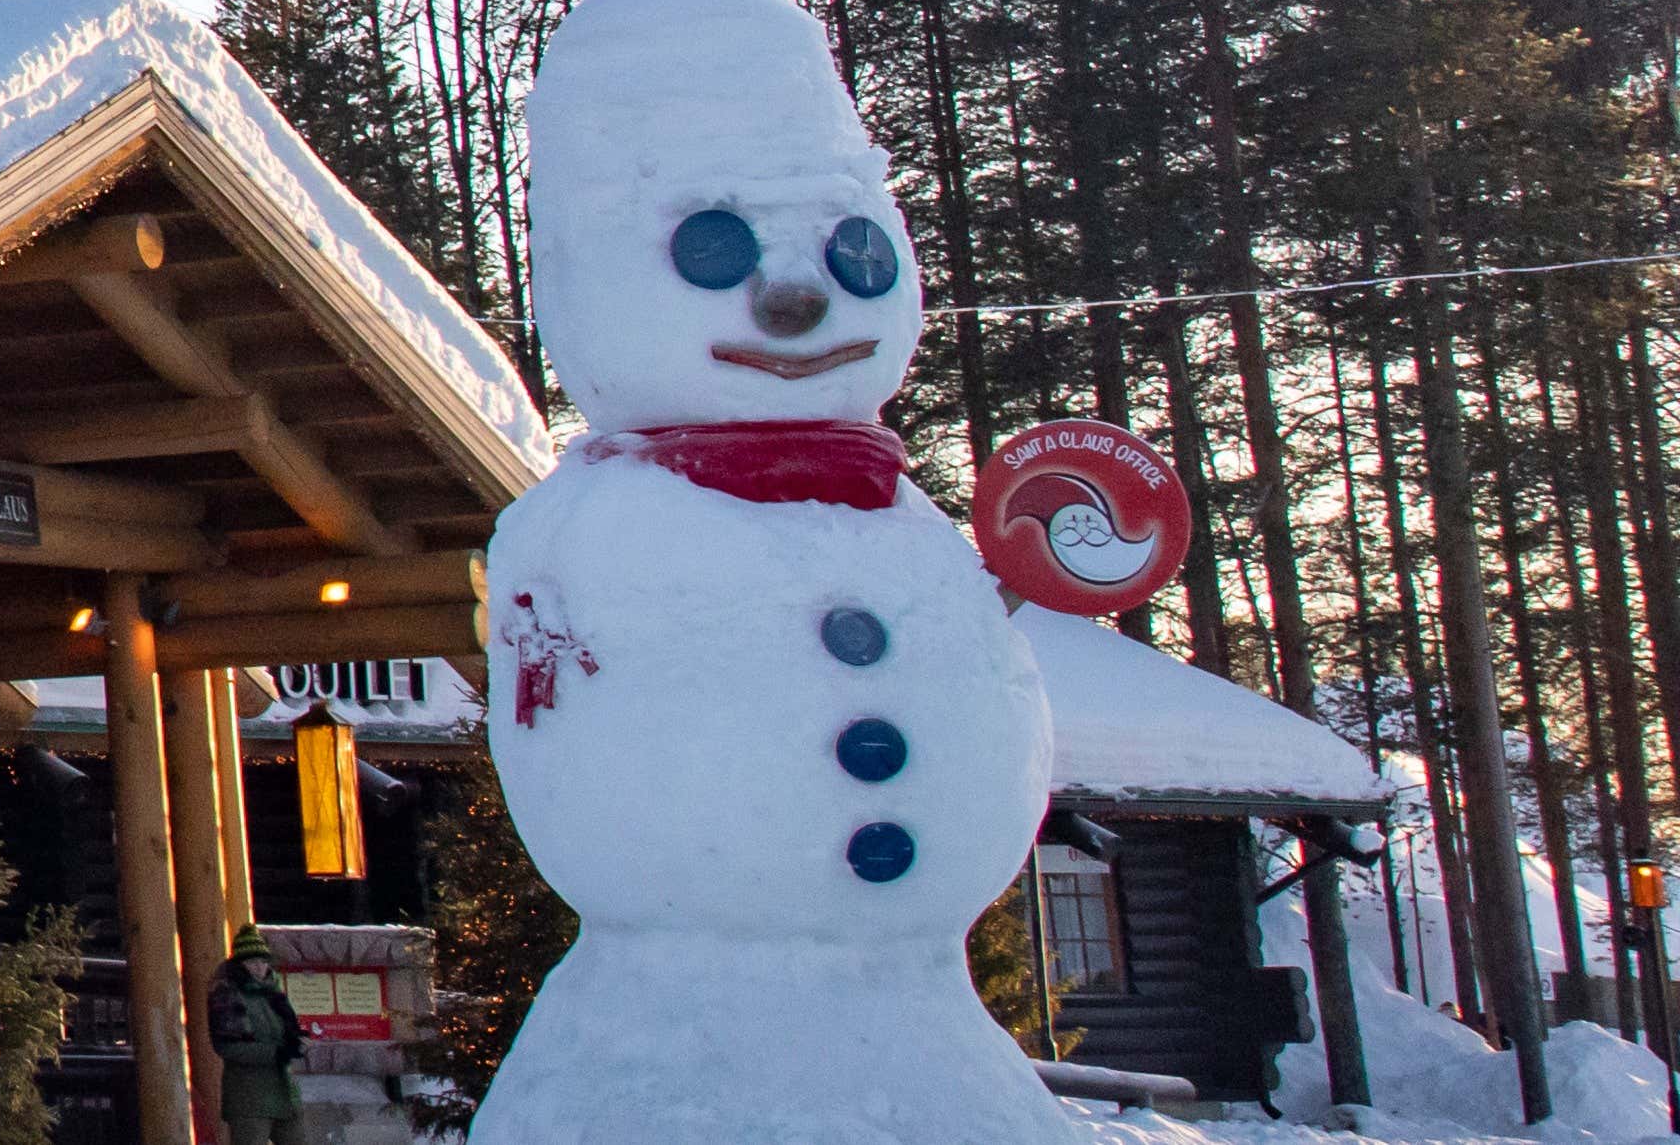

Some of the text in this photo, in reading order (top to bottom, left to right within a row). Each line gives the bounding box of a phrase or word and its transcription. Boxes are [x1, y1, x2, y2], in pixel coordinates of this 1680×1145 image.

[1003, 431, 1168, 491] SANTA CLAUS OFFICE
[279, 657, 440, 703] OUTLET
